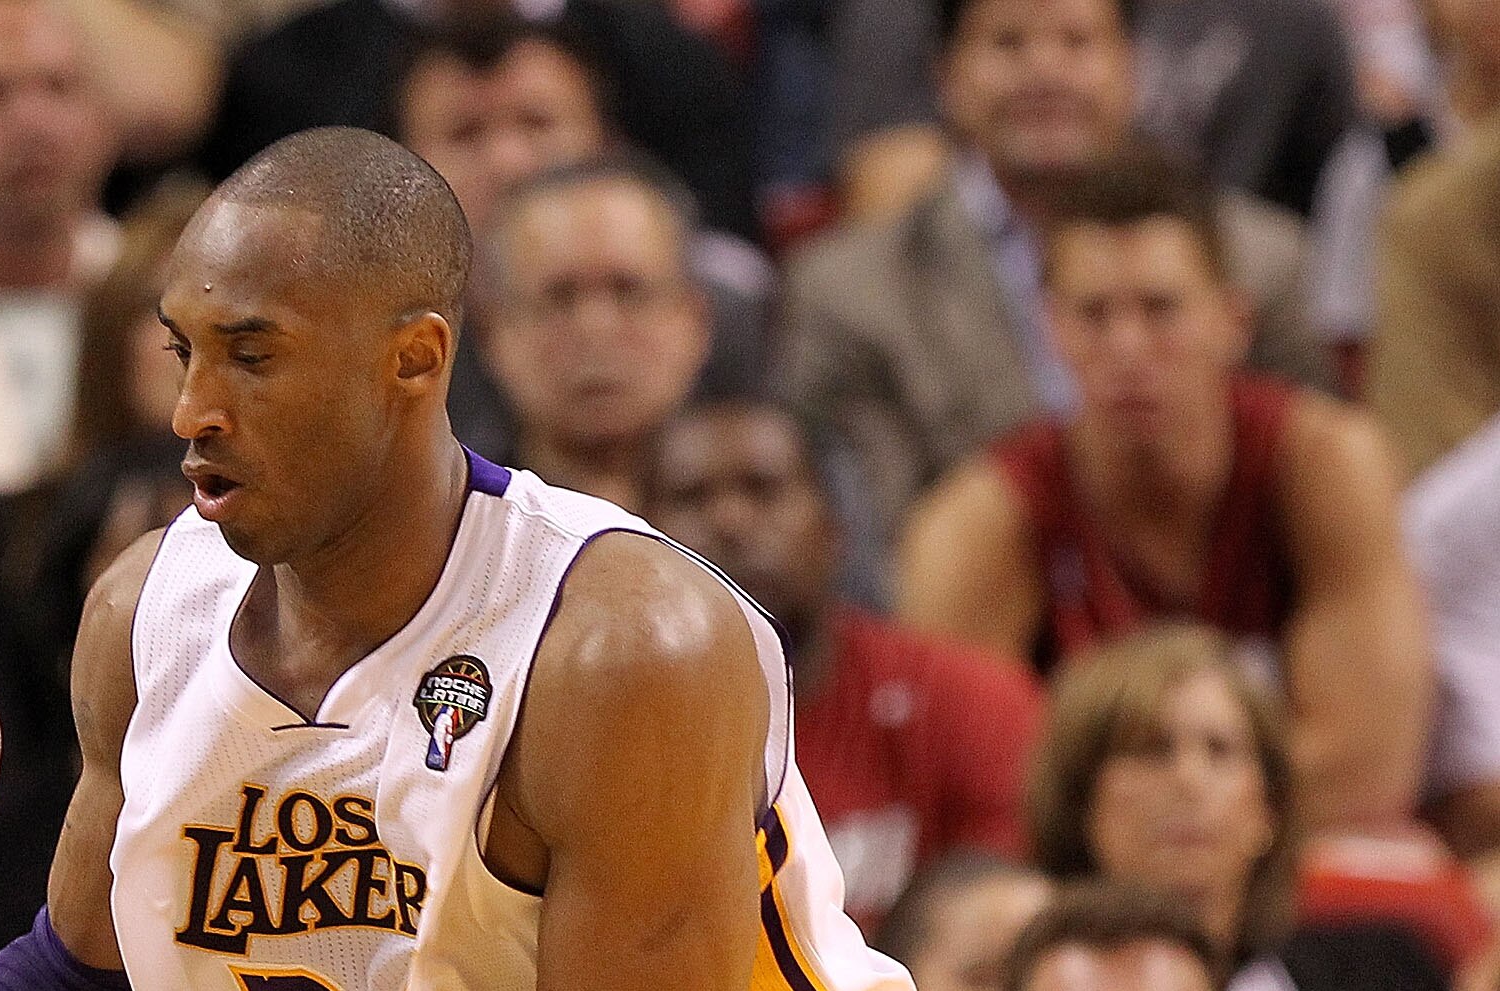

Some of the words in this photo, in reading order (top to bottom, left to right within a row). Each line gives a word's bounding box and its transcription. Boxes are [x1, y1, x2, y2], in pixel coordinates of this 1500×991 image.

[420, 688, 486, 713] LATINA
[426, 676, 487, 700] NOCHE
[232, 781, 384, 854] LOS
